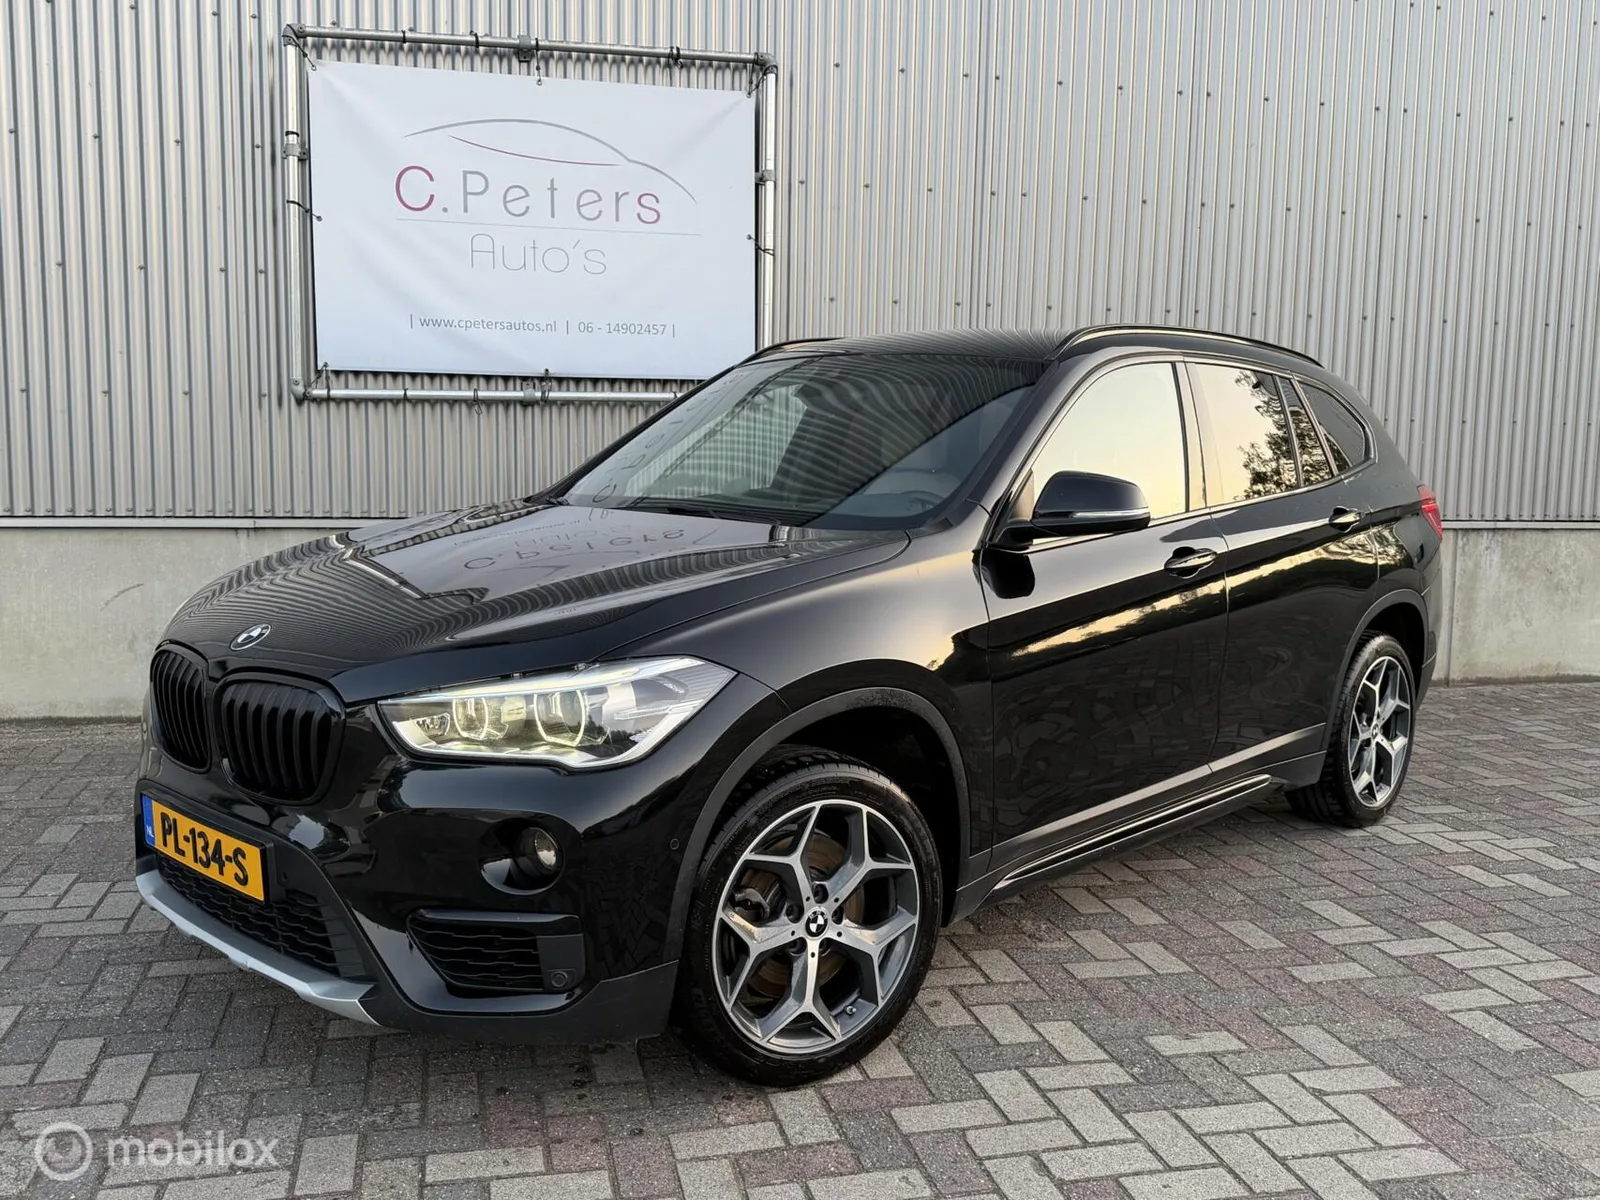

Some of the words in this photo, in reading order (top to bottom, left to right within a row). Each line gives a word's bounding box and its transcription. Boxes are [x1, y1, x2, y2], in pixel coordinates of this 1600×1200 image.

[395, 165, 661, 224] C.Peters
[419, 316, 557, 333] www.cpetersautos.nl
[606, 322, 667, 336] 14902457
[160, 811, 249, 887] PL-134-S
